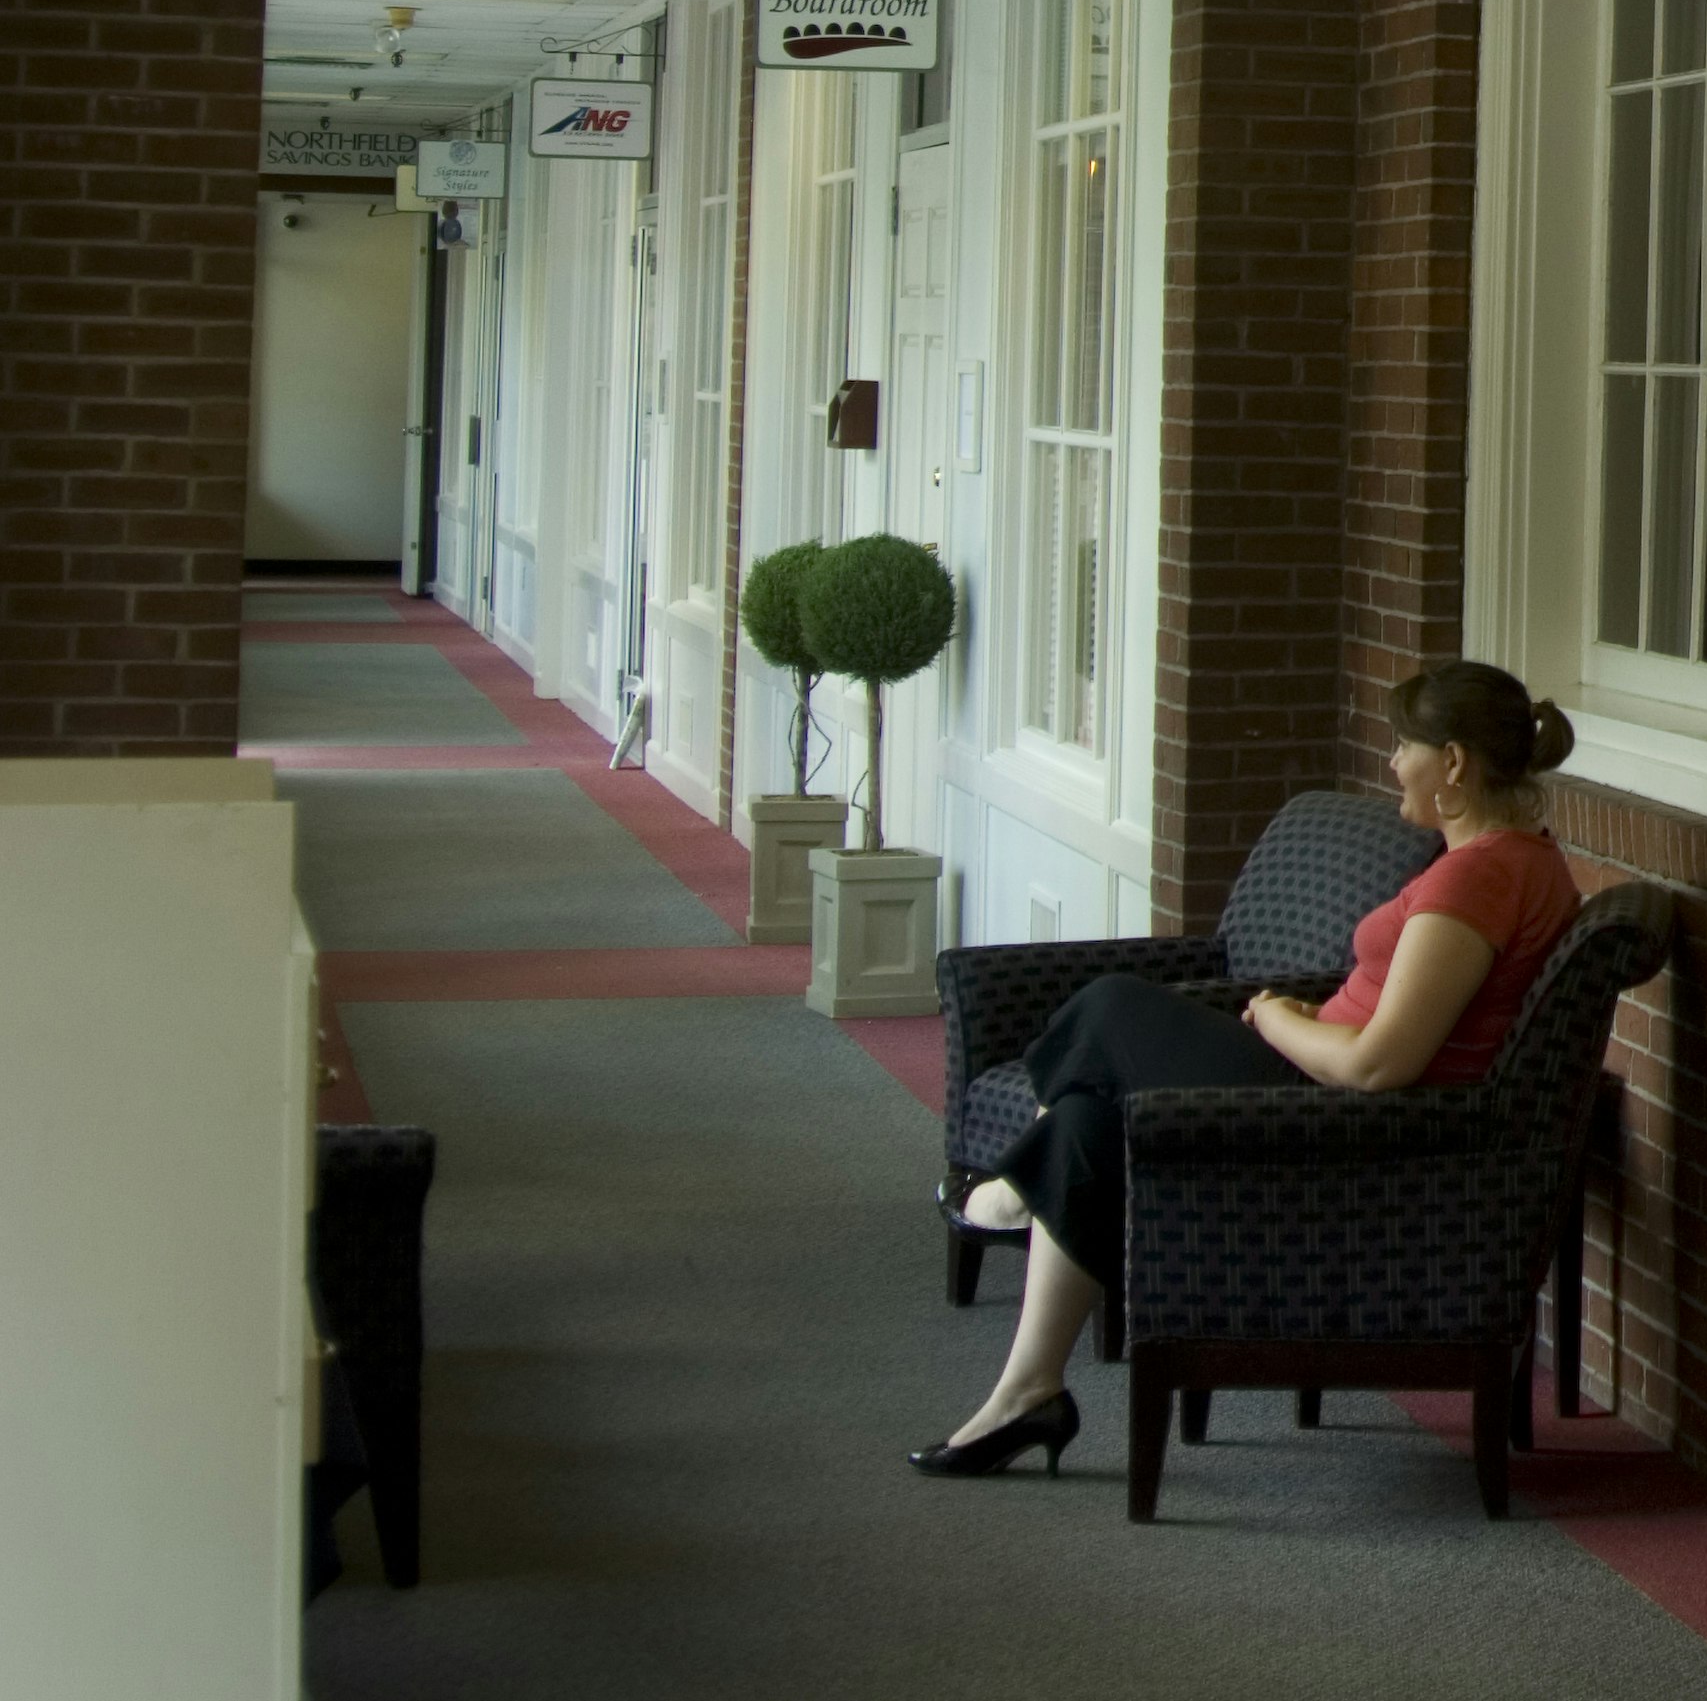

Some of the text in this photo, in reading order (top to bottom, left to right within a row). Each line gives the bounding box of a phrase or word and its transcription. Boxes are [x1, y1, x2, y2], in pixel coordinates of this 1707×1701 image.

[539, 106, 631, 135] ANG
[267, 130, 417, 153] NORTHFIELD
[266, 149, 416, 168] SAVINGS BANK
[443, 180, 479, 195] Styles
